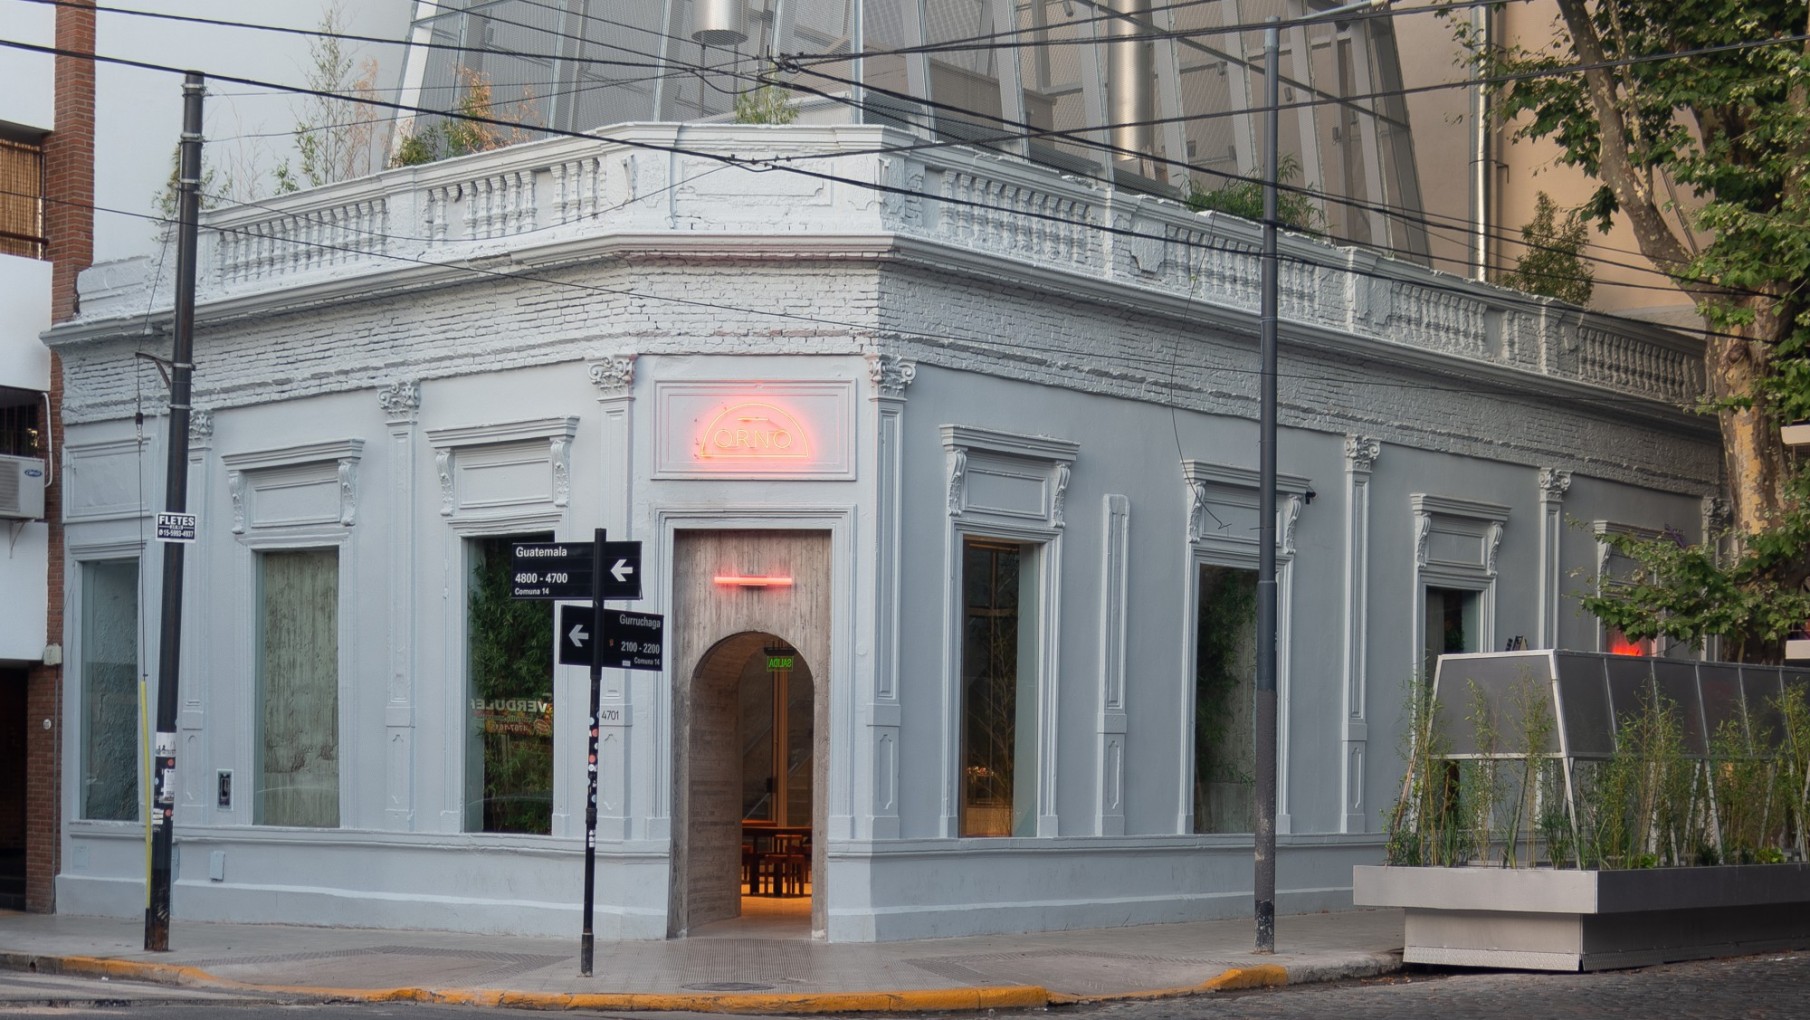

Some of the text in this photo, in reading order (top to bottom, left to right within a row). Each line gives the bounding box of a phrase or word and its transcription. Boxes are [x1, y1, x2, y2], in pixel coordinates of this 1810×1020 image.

[714, 429, 792, 448] ORNO
[159, 515, 194, 526] FLETES
[515, 546, 567, 557] Guatemala
[515, 573, 538, 583] 4800
[545, 573, 568, 583] 4700
[619, 614, 661, 630] Gurruchaga
[621, 641, 637, 652] 2100
[643, 643, 660, 654] 2200
[634, 657, 653, 665] Comuna
[601, 710, 619, 721] 4701
